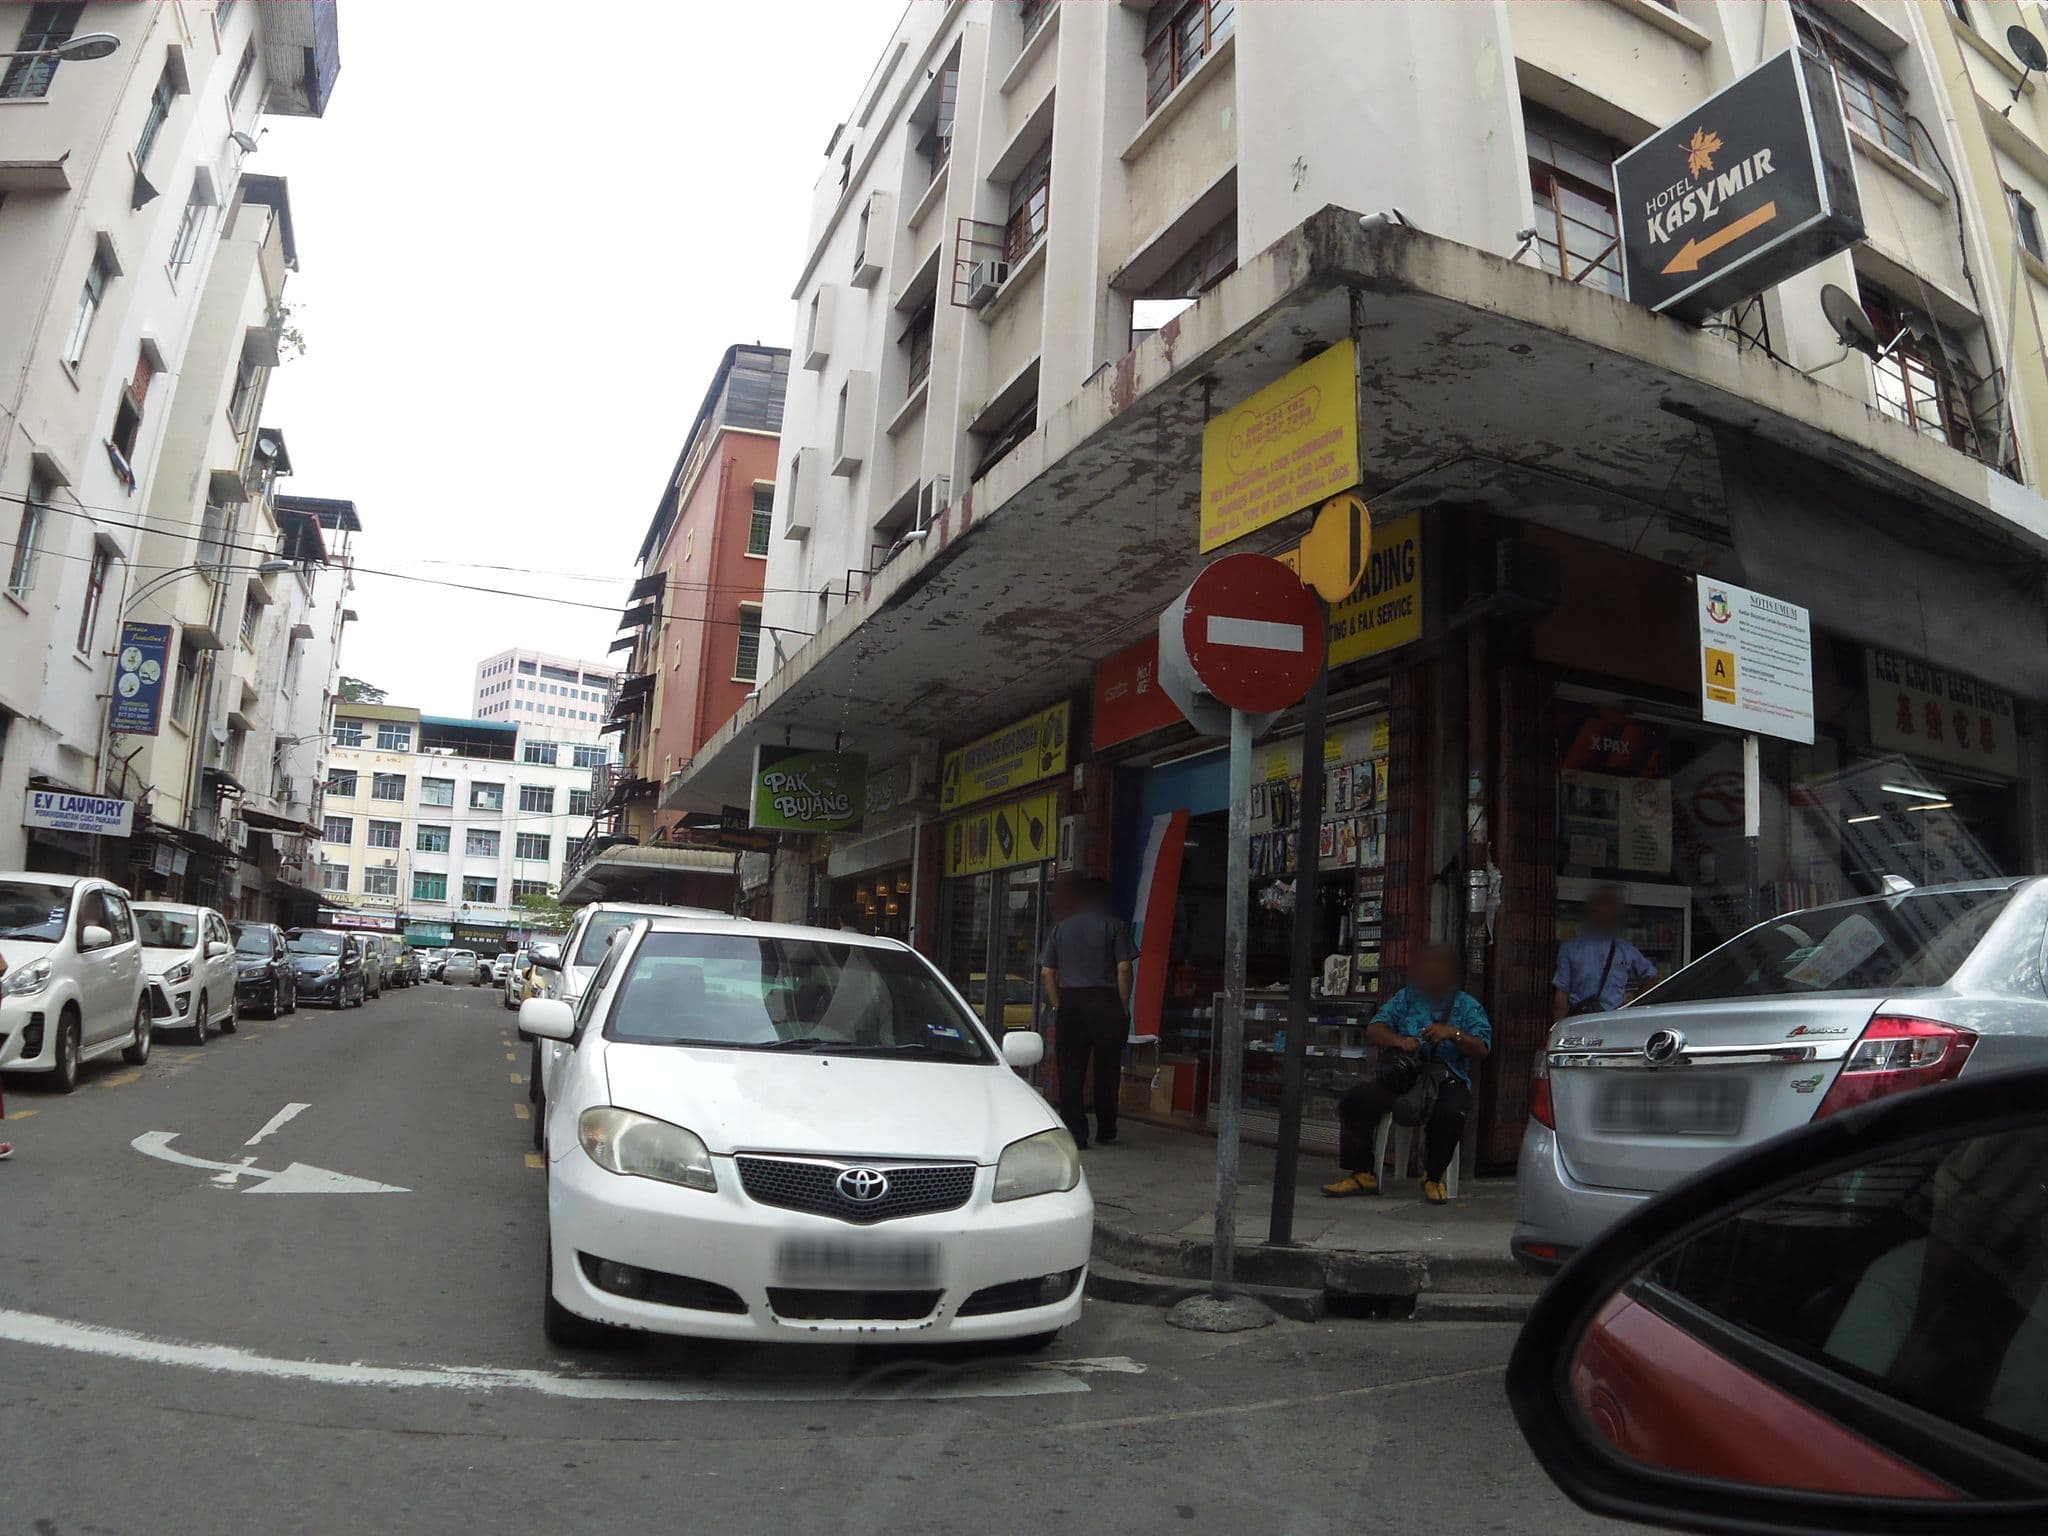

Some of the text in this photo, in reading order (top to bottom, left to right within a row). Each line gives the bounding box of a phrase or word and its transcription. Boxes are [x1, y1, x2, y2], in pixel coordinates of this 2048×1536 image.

[1646, 177, 1694, 215] HOTEL
[1647, 148, 1775, 244] KASYMIR
[1350, 616, 1356, 636] &
[1358, 608, 1375, 632] FAX
[1377, 595, 1413, 626] SERVICE
[1750, 594, 1797, 619] NOTIS UMUM
[1714, 659, 1726, 678] A
[591, 766, 599, 806] HOTEL
[763, 772, 822, 797] PAK
[33, 793, 125, 817] E.V LAUNDRY
[774, 795, 854, 821] BUJANG
[50, 819, 103, 833] LAUNDRY SERVICE
